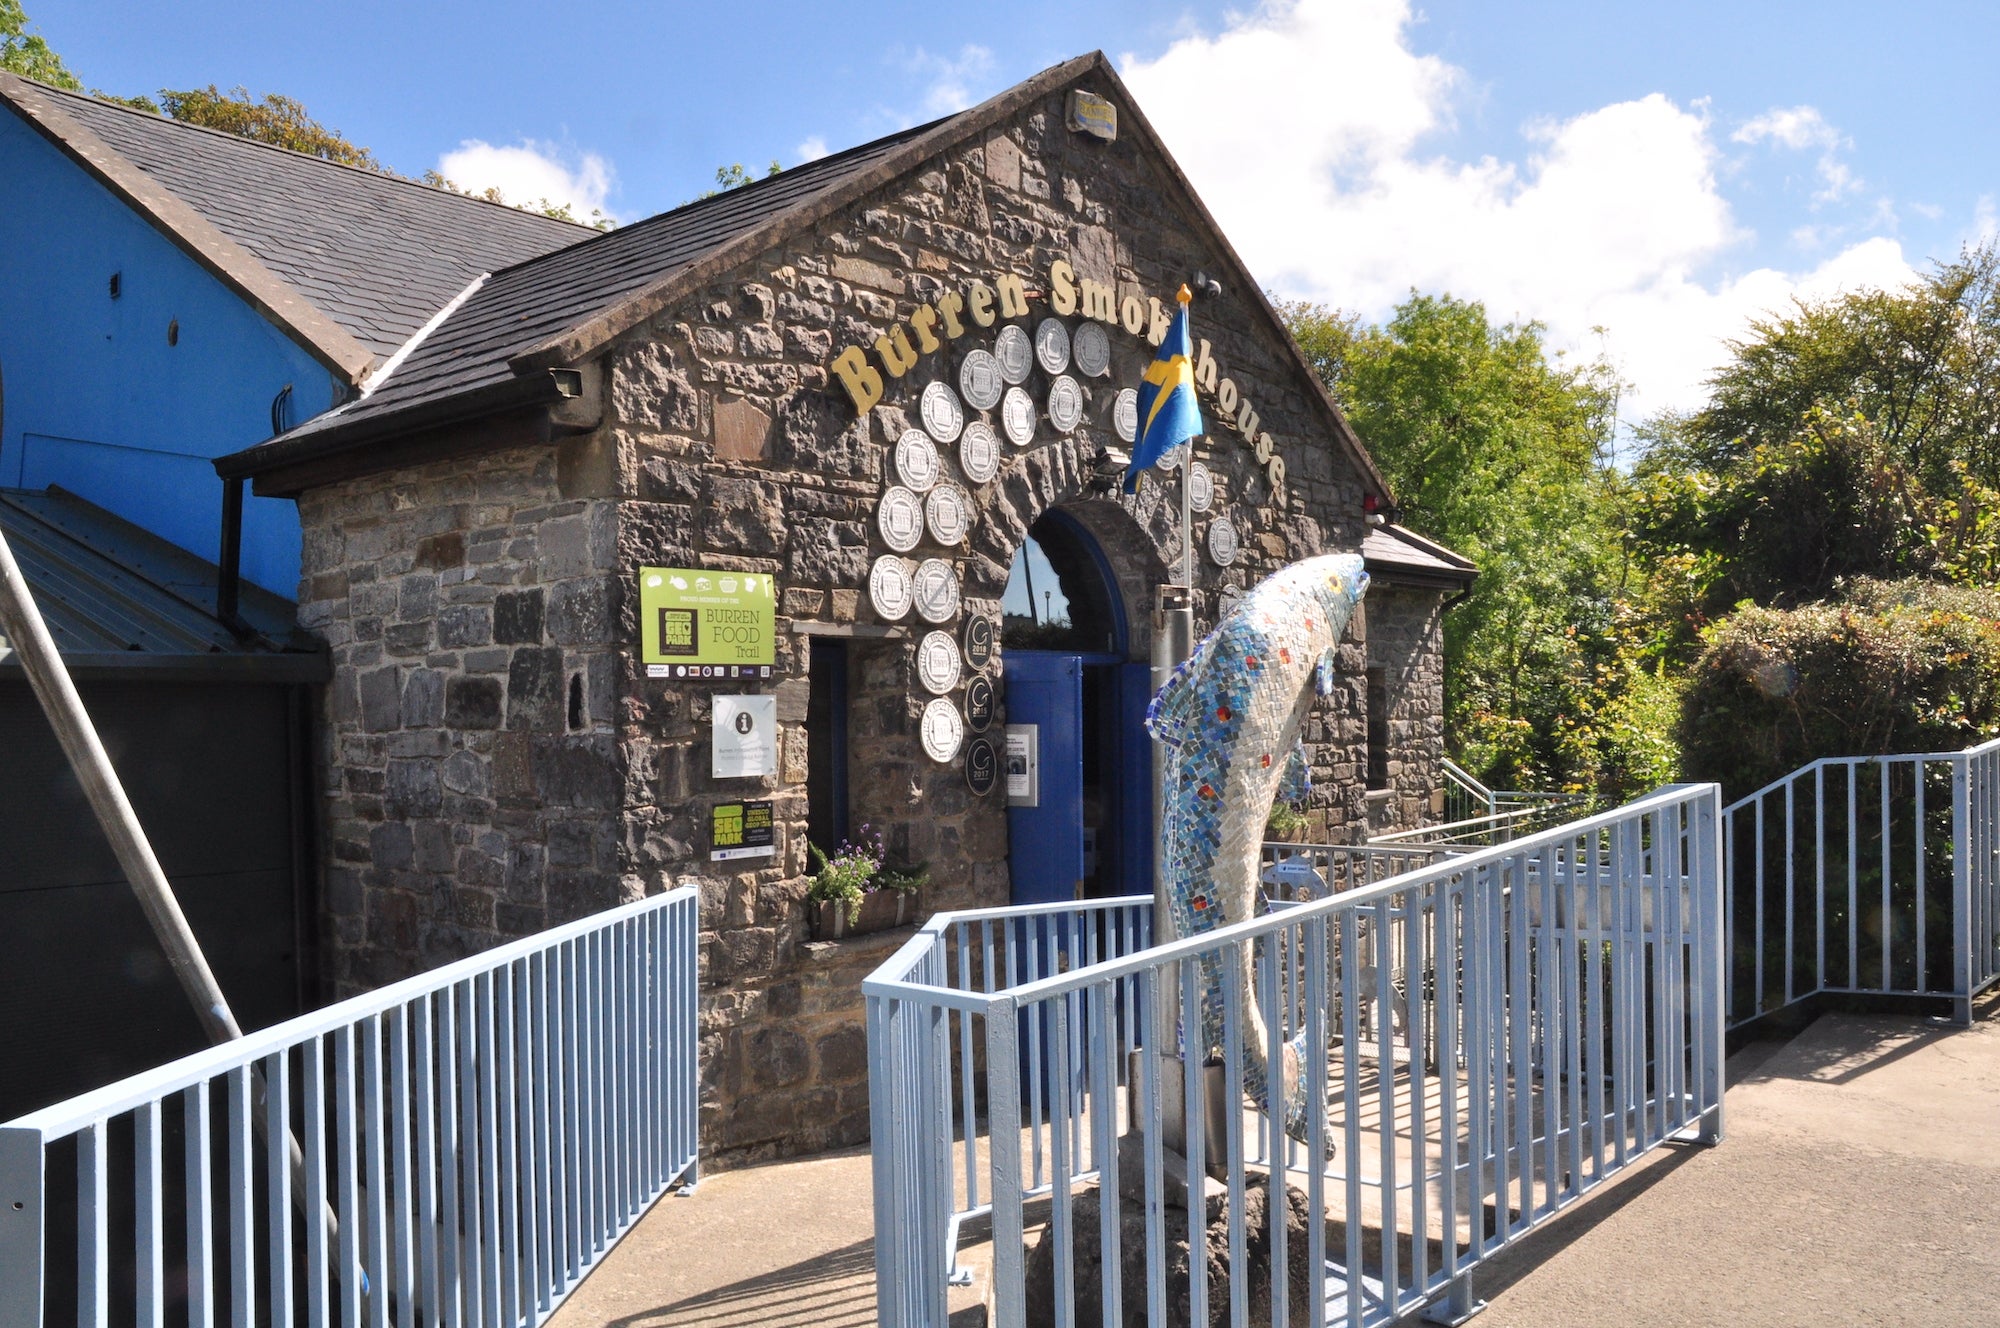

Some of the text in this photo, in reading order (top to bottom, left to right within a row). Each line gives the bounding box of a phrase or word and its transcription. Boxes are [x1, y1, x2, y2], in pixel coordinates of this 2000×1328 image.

[832, 260, 1285, 488] Burren Smokhouse
[706, 608, 760, 624] BURREN
[713, 626, 760, 644] FOOD
[736, 646, 760, 658] Trail
[974, 770, 988, 778] 2017
[714, 832, 742, 846] PARK
